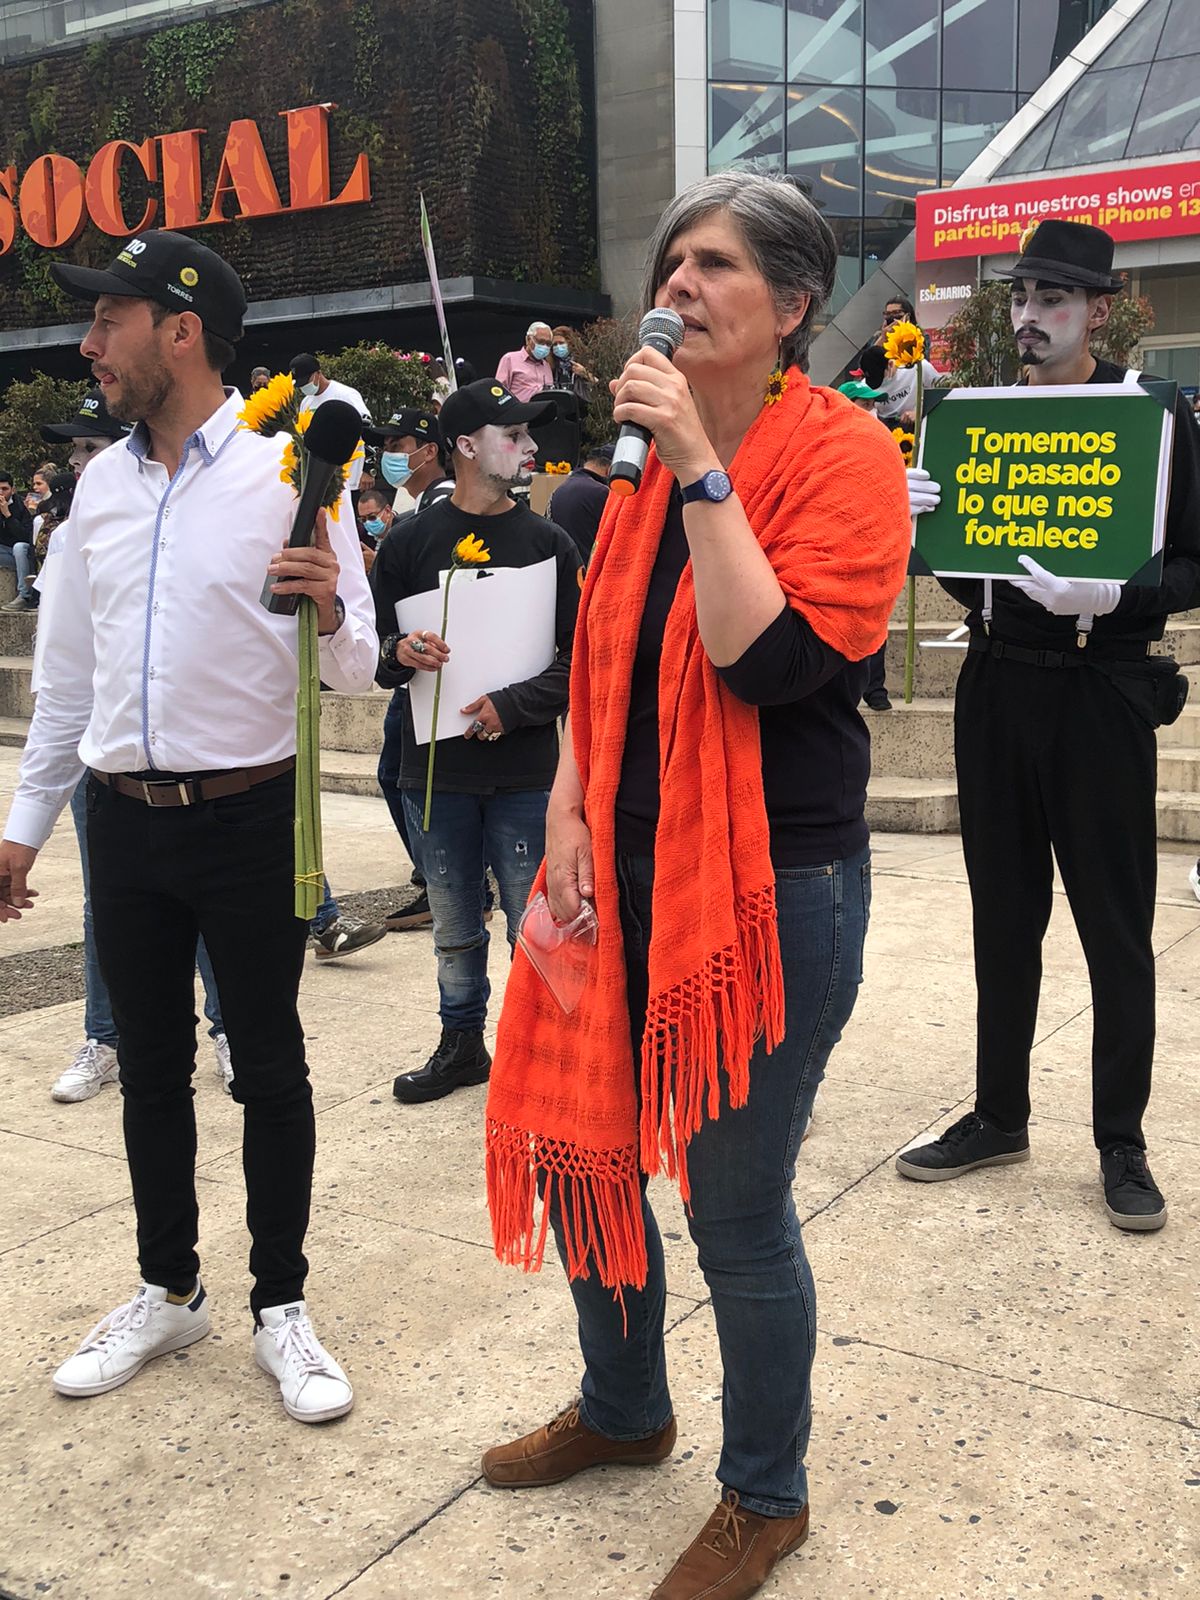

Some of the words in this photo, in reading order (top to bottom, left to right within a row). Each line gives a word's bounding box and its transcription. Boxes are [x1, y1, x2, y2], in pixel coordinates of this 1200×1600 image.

[934, 203, 1009, 225] Disfruta
[1014, 192, 1100, 216] nuestros
[1107, 184, 1173, 205] shows
[934, 220, 1021, 247] participa
[1098, 204, 1172, 226] iPhone
[1178, 198, 1200, 217] 13
[125, 239, 147, 255] 110
[167, 283, 193, 302] TORRES
[920, 284, 972, 302] ESCENARIOS
[83, 398, 99, 410] 110
[966, 427, 1117, 454] Tomemos
[955, 457, 1001, 484] del
[1008, 457, 1121, 490] pasado
[957, 488, 985, 515] lo
[992, 494, 1049, 520] que
[1057, 495, 1113, 518] nos
[965, 518, 1099, 549] fortalece
